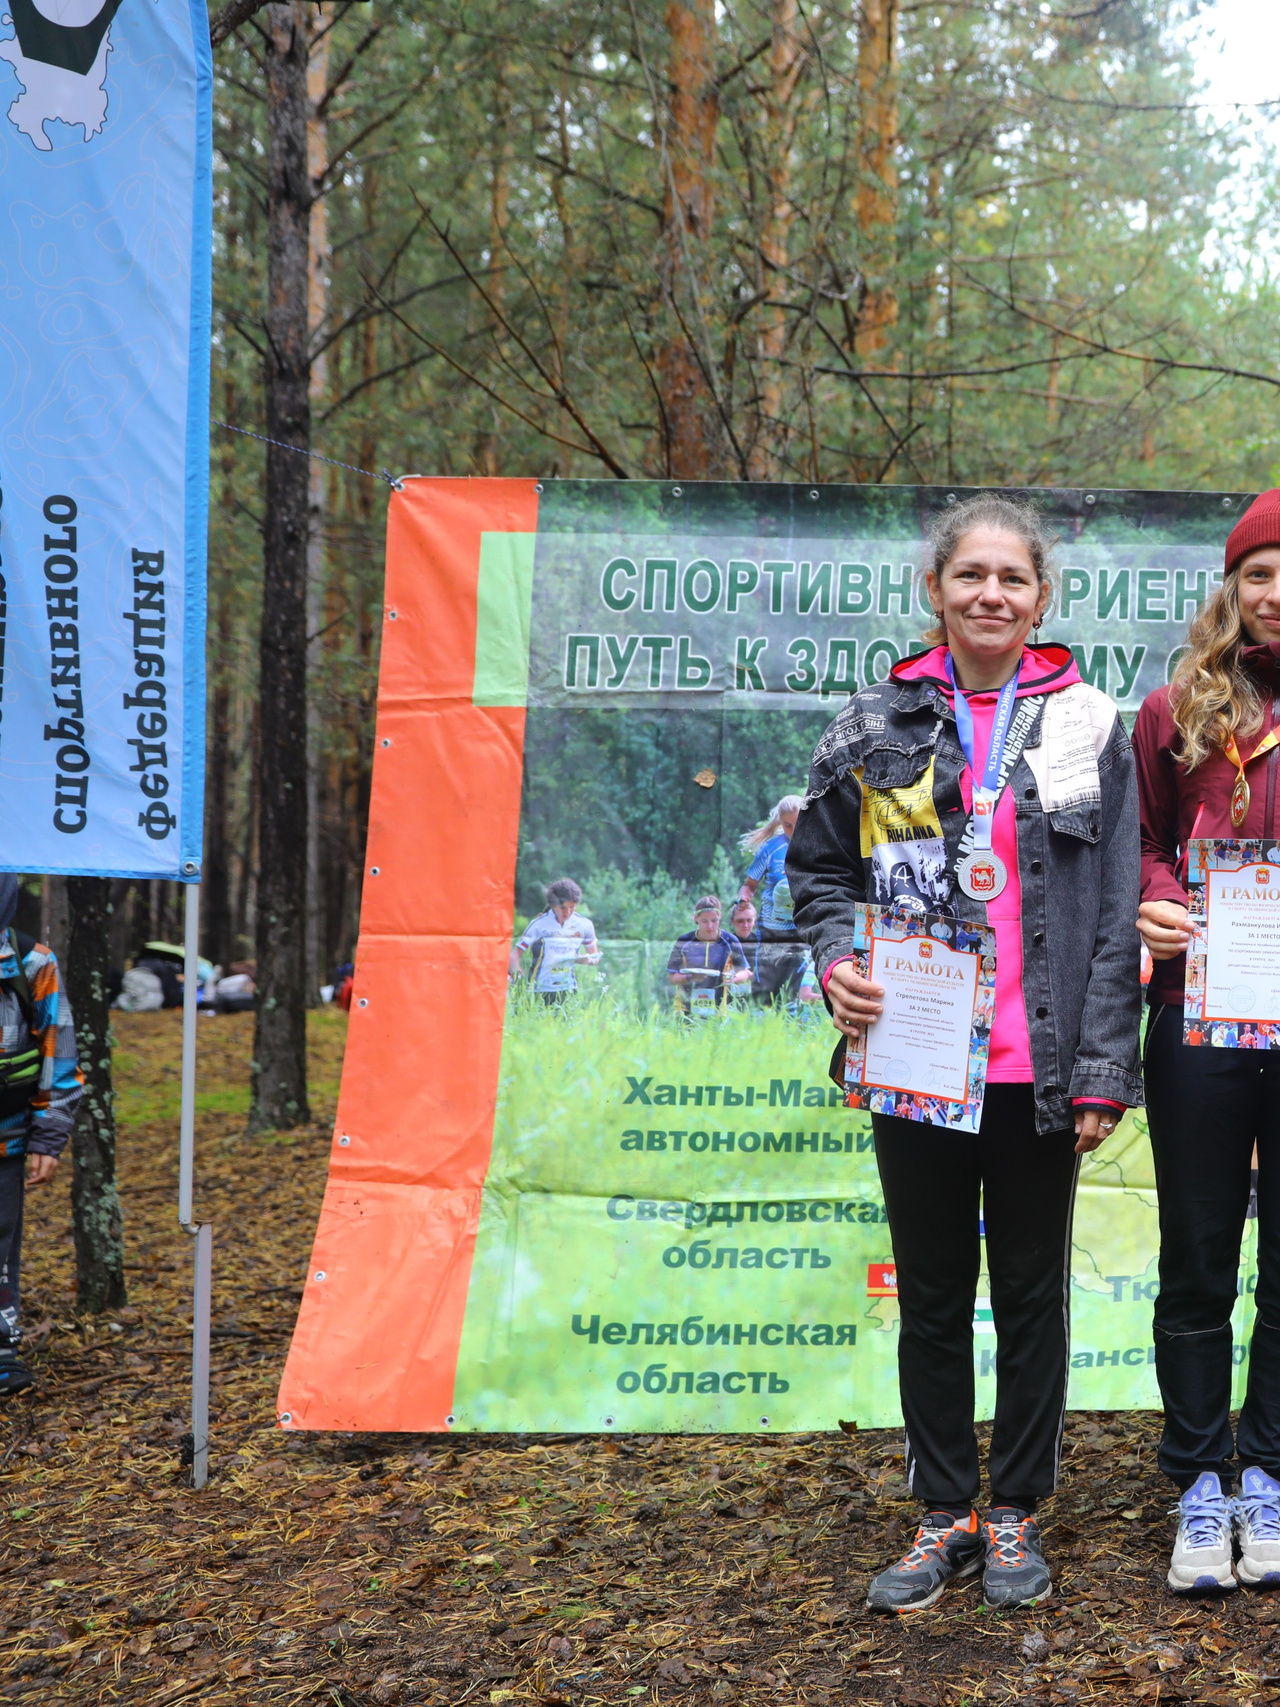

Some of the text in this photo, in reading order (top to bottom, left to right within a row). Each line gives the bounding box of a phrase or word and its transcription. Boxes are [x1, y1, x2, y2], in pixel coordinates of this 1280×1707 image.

[602, 556, 929, 617] СПОРТИВН
[565, 633, 713, 692] ПУТЬ
[734, 636, 767, 692] К
[835, 726, 862, 740] YOUR
[864, 719, 886, 728] THIS
[1004, 711, 1027, 750] LIMITED
[1011, 715, 1035, 758] EDITION
[988, 726, 1003, 772] ОБЛАСТЬ
[886, 825, 937, 843] RIHANNA
[1231, 921, 1275, 929] Рахманкулова
[884, 954, 965, 981] ГРАМОТА
[895, 991, 954, 1007] Стрепетова Марина
[921, 1006, 940, 1015] МЕСТО
[622, 1076, 845, 1107] Ханты-Ман
[620, 1124, 877, 1153] автономный
[662, 1240, 832, 1270] область
[571, 1314, 858, 1347] Челябинская
[616, 1363, 790, 1395] область
